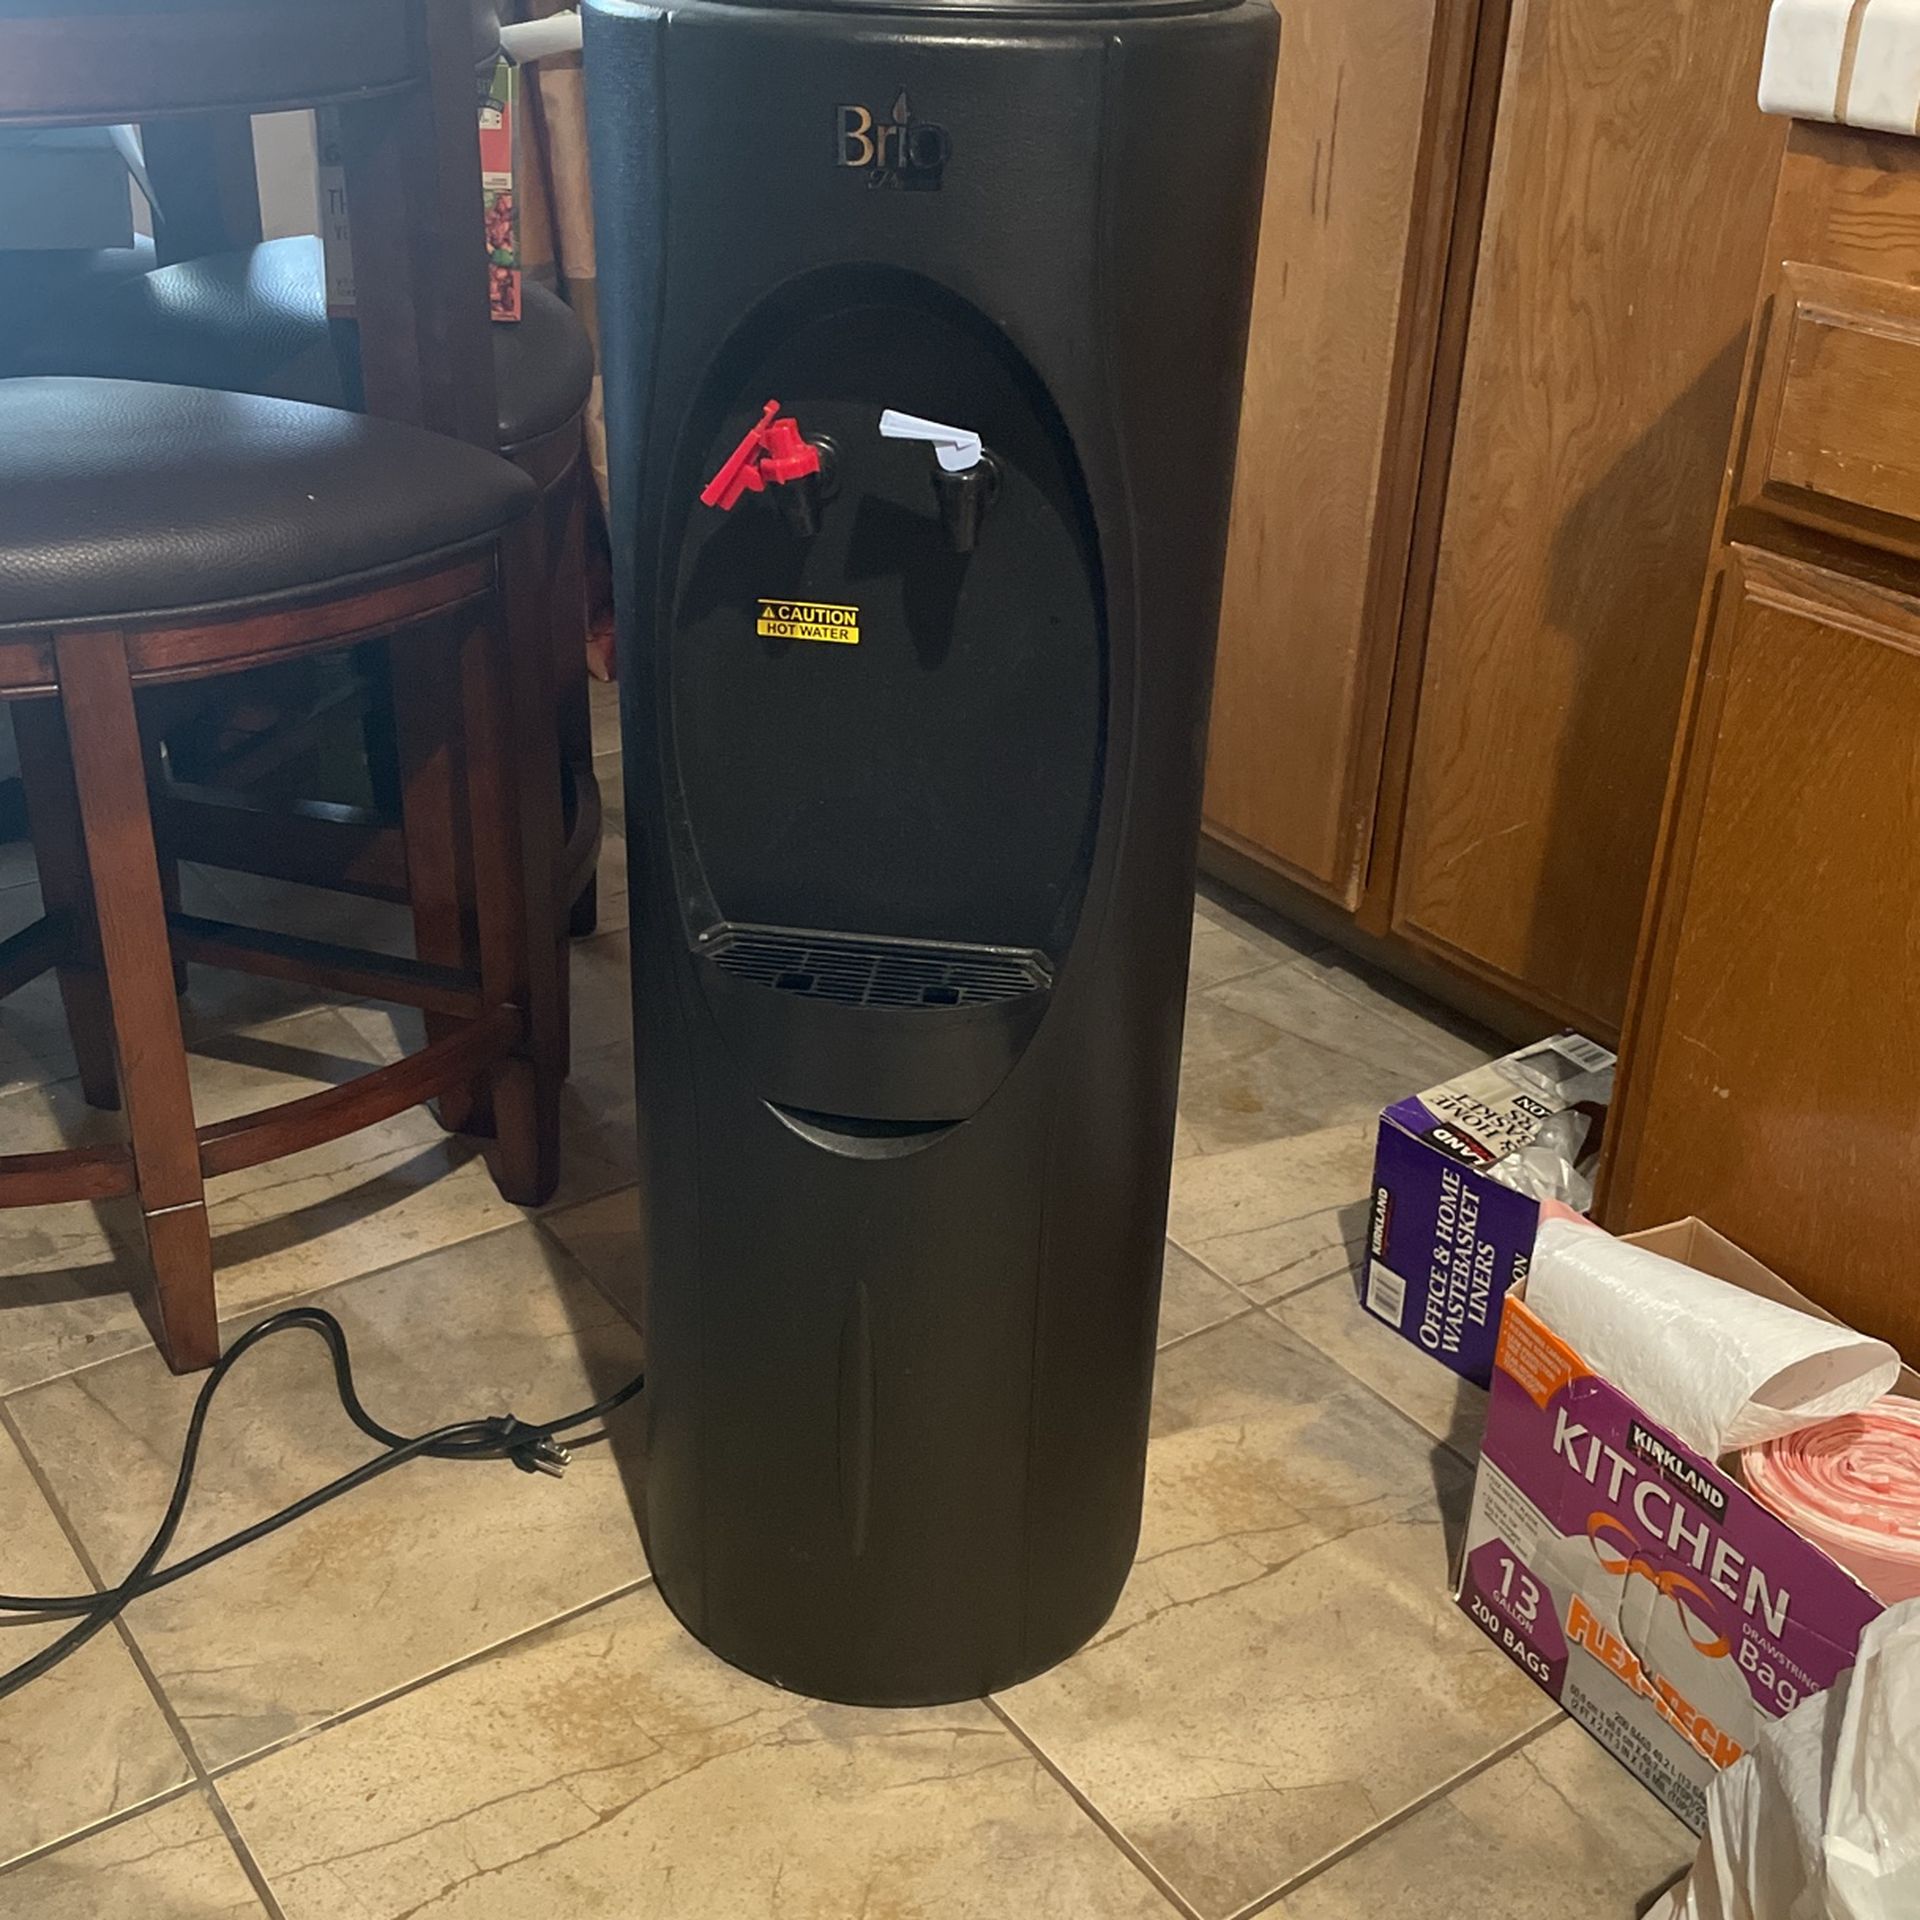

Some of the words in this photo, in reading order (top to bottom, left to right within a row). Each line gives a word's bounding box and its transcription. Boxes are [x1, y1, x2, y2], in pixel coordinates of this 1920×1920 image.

[767, 623, 796, 635] HOT
[800, 625, 849, 640] WATER
[778, 606, 856, 626] CAUTION
[1431, 1094, 1500, 1138] HOME
[1371, 1188, 1389, 1256] KIRKLAND
[1435, 1167, 1460, 1244] HOME
[1433, 1245, 1450, 1265] &
[1441, 1184, 1480, 1353] WASTEBASKET
[1467, 1240, 1495, 1327] LINERS
[1419, 1265, 1448, 1350] OFFICE
[1632, 1424, 1725, 1510] KIRKLAND
[1553, 1406, 1790, 1639] KITCHEN
[1492, 1589, 1535, 1634] GALLON
[1499, 1558, 1540, 1621] 13
[1471, 1595, 1500, 1633] 200
[1502, 1627, 1551, 1682] BAGS
